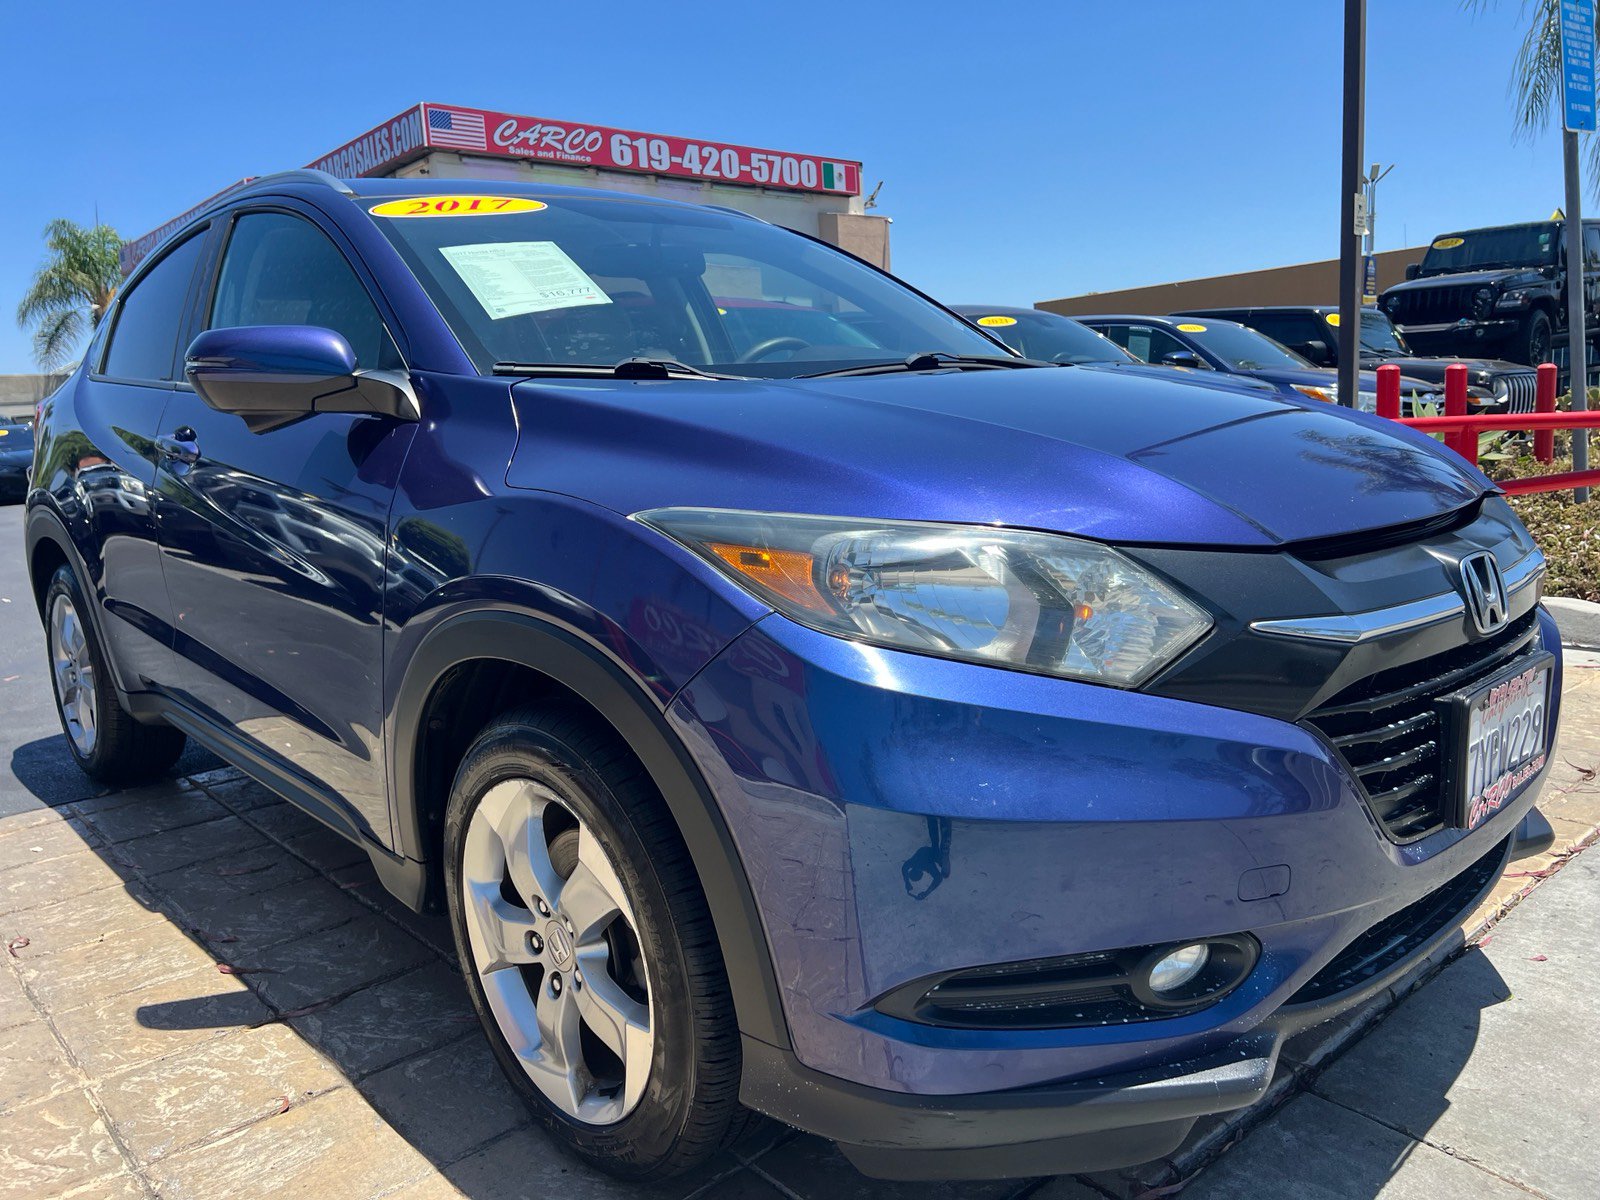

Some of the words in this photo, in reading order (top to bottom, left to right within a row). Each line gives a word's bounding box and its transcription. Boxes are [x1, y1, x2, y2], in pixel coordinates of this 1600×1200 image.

[493, 119, 603, 154] CARCO
[508, 145, 535, 156] Sales
[537, 149, 554, 159] and
[556, 152, 592, 163] Finance
[610, 133, 818, 188] 619-420-5700
[406, 199, 512, 215] 2017
